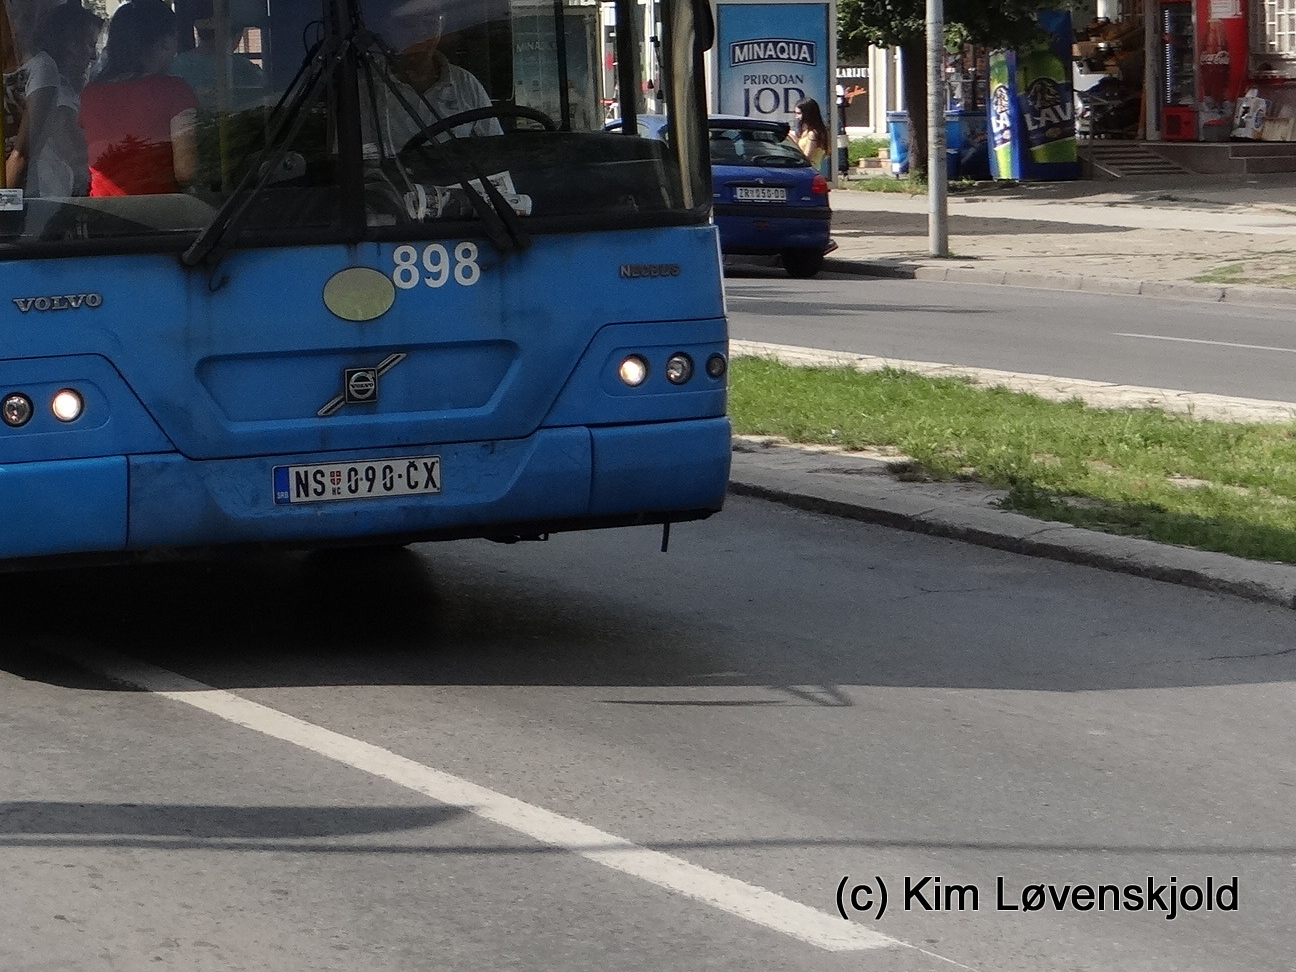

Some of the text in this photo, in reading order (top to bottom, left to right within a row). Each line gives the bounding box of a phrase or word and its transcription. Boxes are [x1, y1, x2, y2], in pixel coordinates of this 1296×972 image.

[734, 42, 812, 63] MINAQUA
[743, 74, 804, 85] PRIRODAN
[742, 87, 806, 117] JOD
[1024, 102, 1073, 131] LAV
[391, 242, 482, 290] 898
[13, 292, 103, 313] VOLVO
[295, 469, 326, 498] NS
